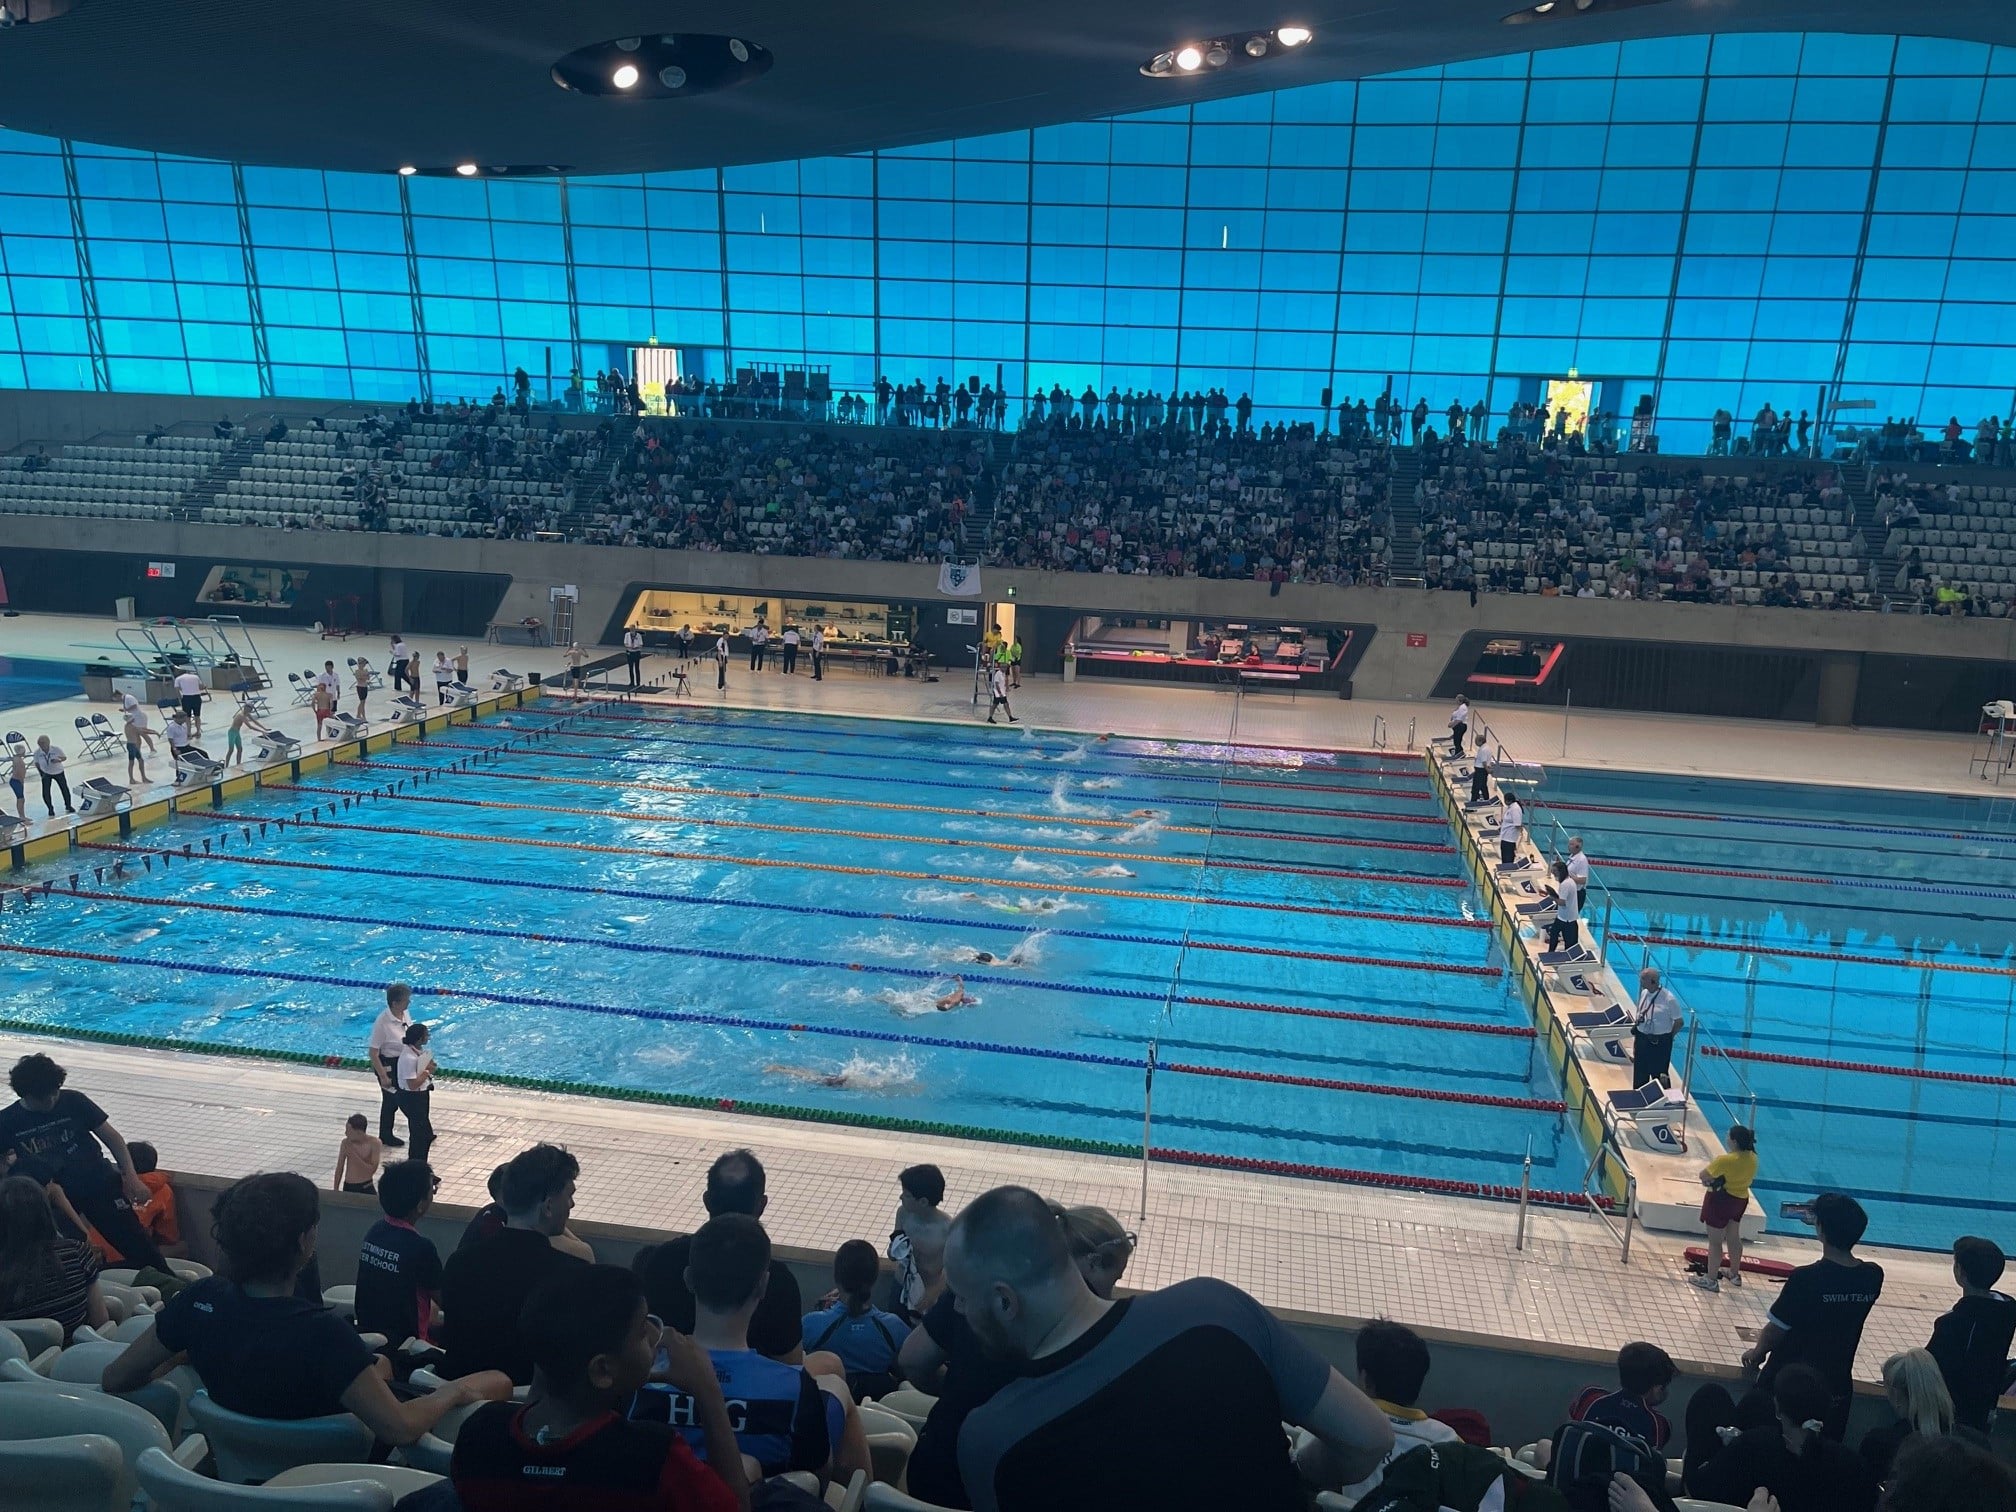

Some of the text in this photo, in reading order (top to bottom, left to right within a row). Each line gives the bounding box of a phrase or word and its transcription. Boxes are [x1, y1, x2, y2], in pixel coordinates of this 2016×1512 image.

[1575, 978, 1583, 989] 2
[1658, 1128, 1668, 1141] 0
[369, 1256, 400, 1273] SCHOOL
[1822, 1294, 1848, 1303] SWIM
[522, 1465, 567, 1476] GILBERT
